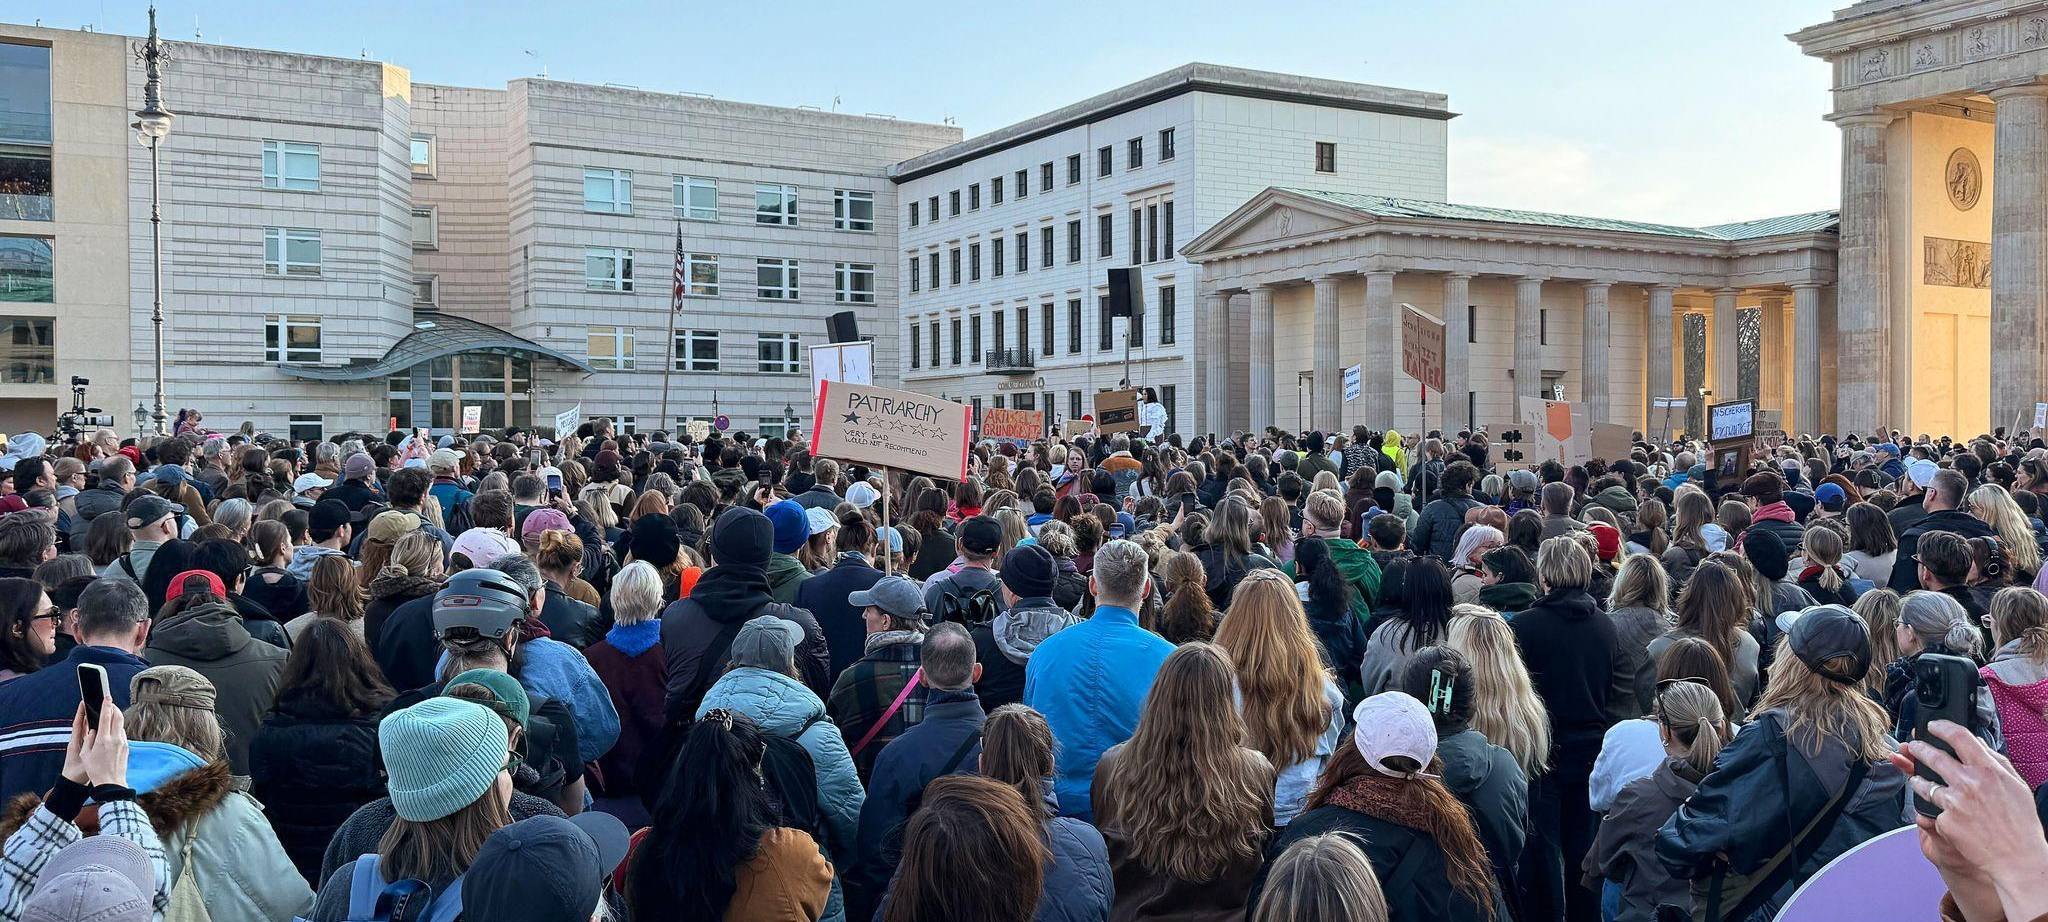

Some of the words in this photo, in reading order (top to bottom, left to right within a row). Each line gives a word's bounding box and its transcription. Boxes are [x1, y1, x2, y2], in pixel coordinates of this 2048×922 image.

[848, 392, 944, 424] PATRIARCHY
[984, 409, 1027, 424] ARTIKEL
[843, 429, 867, 438] VERY
[872, 433, 889, 441] BAD
[845, 436, 868, 445] WOULD
[884, 443, 928, 456] RECOMMEND
